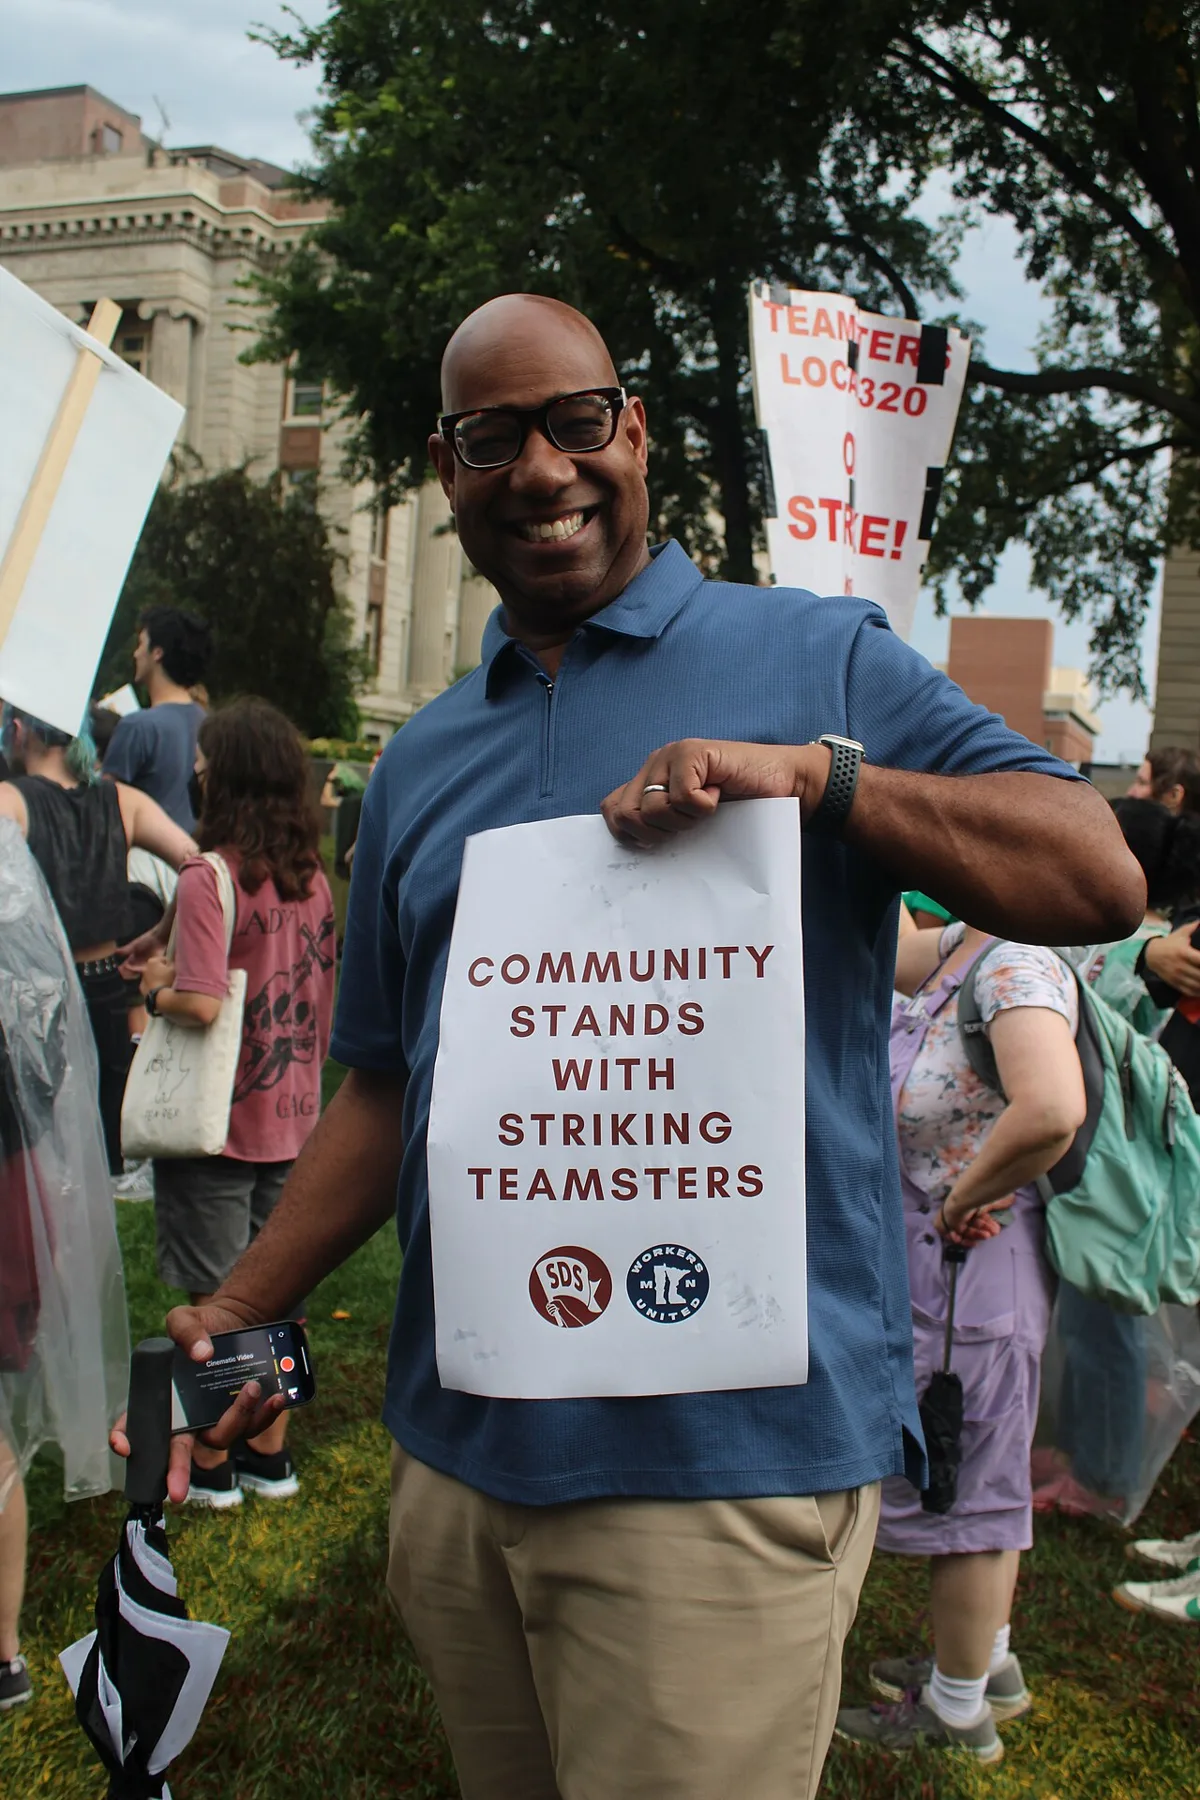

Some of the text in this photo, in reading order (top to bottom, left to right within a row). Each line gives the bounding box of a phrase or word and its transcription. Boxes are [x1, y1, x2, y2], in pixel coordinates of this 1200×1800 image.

[858, 376, 928, 418] 320
[237, 907, 296, 936] ADY
[467, 945, 774, 987] COMMUNITY
[510, 1002, 705, 1037] STANDS
[552, 1058, 675, 1091] WITH
[498, 1111, 733, 1146] STRIKING
[467, 1165, 764, 1201] TEAMSTERS
[545, 1260, 584, 1292] SDS
[631, 1246, 704, 1274] WORKERS
[636, 1297, 701, 1321] UNITED
[205, 1352, 254, 1368] Cinematic Video
